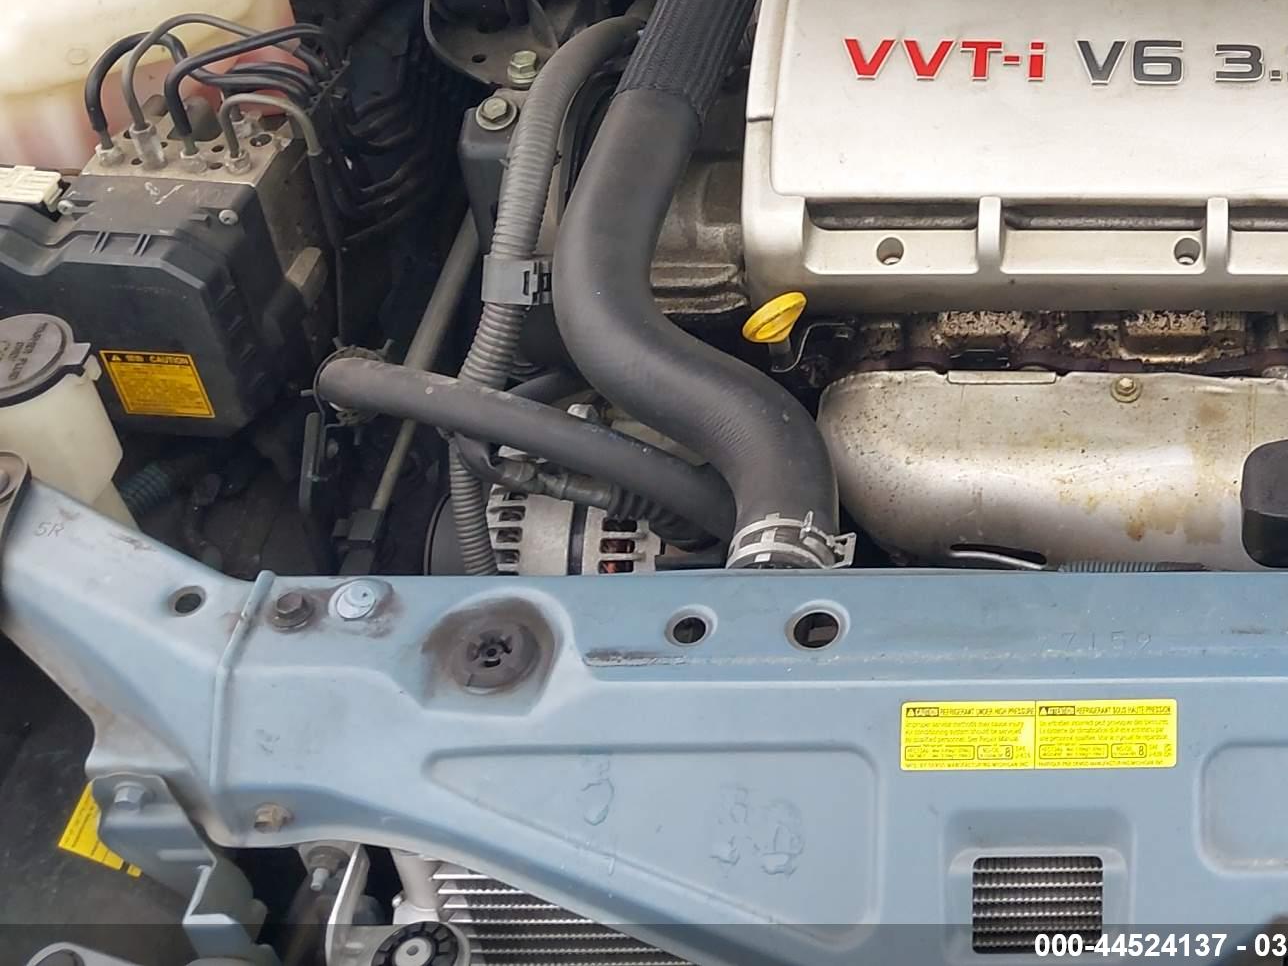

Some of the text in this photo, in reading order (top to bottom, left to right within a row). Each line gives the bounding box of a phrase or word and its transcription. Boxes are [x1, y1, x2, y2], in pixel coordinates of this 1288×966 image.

[843, 38, 1046, 82] VVT-i
[1075, 39, 1184, 85] V6
[150, 355, 189, 365] CAUTION
